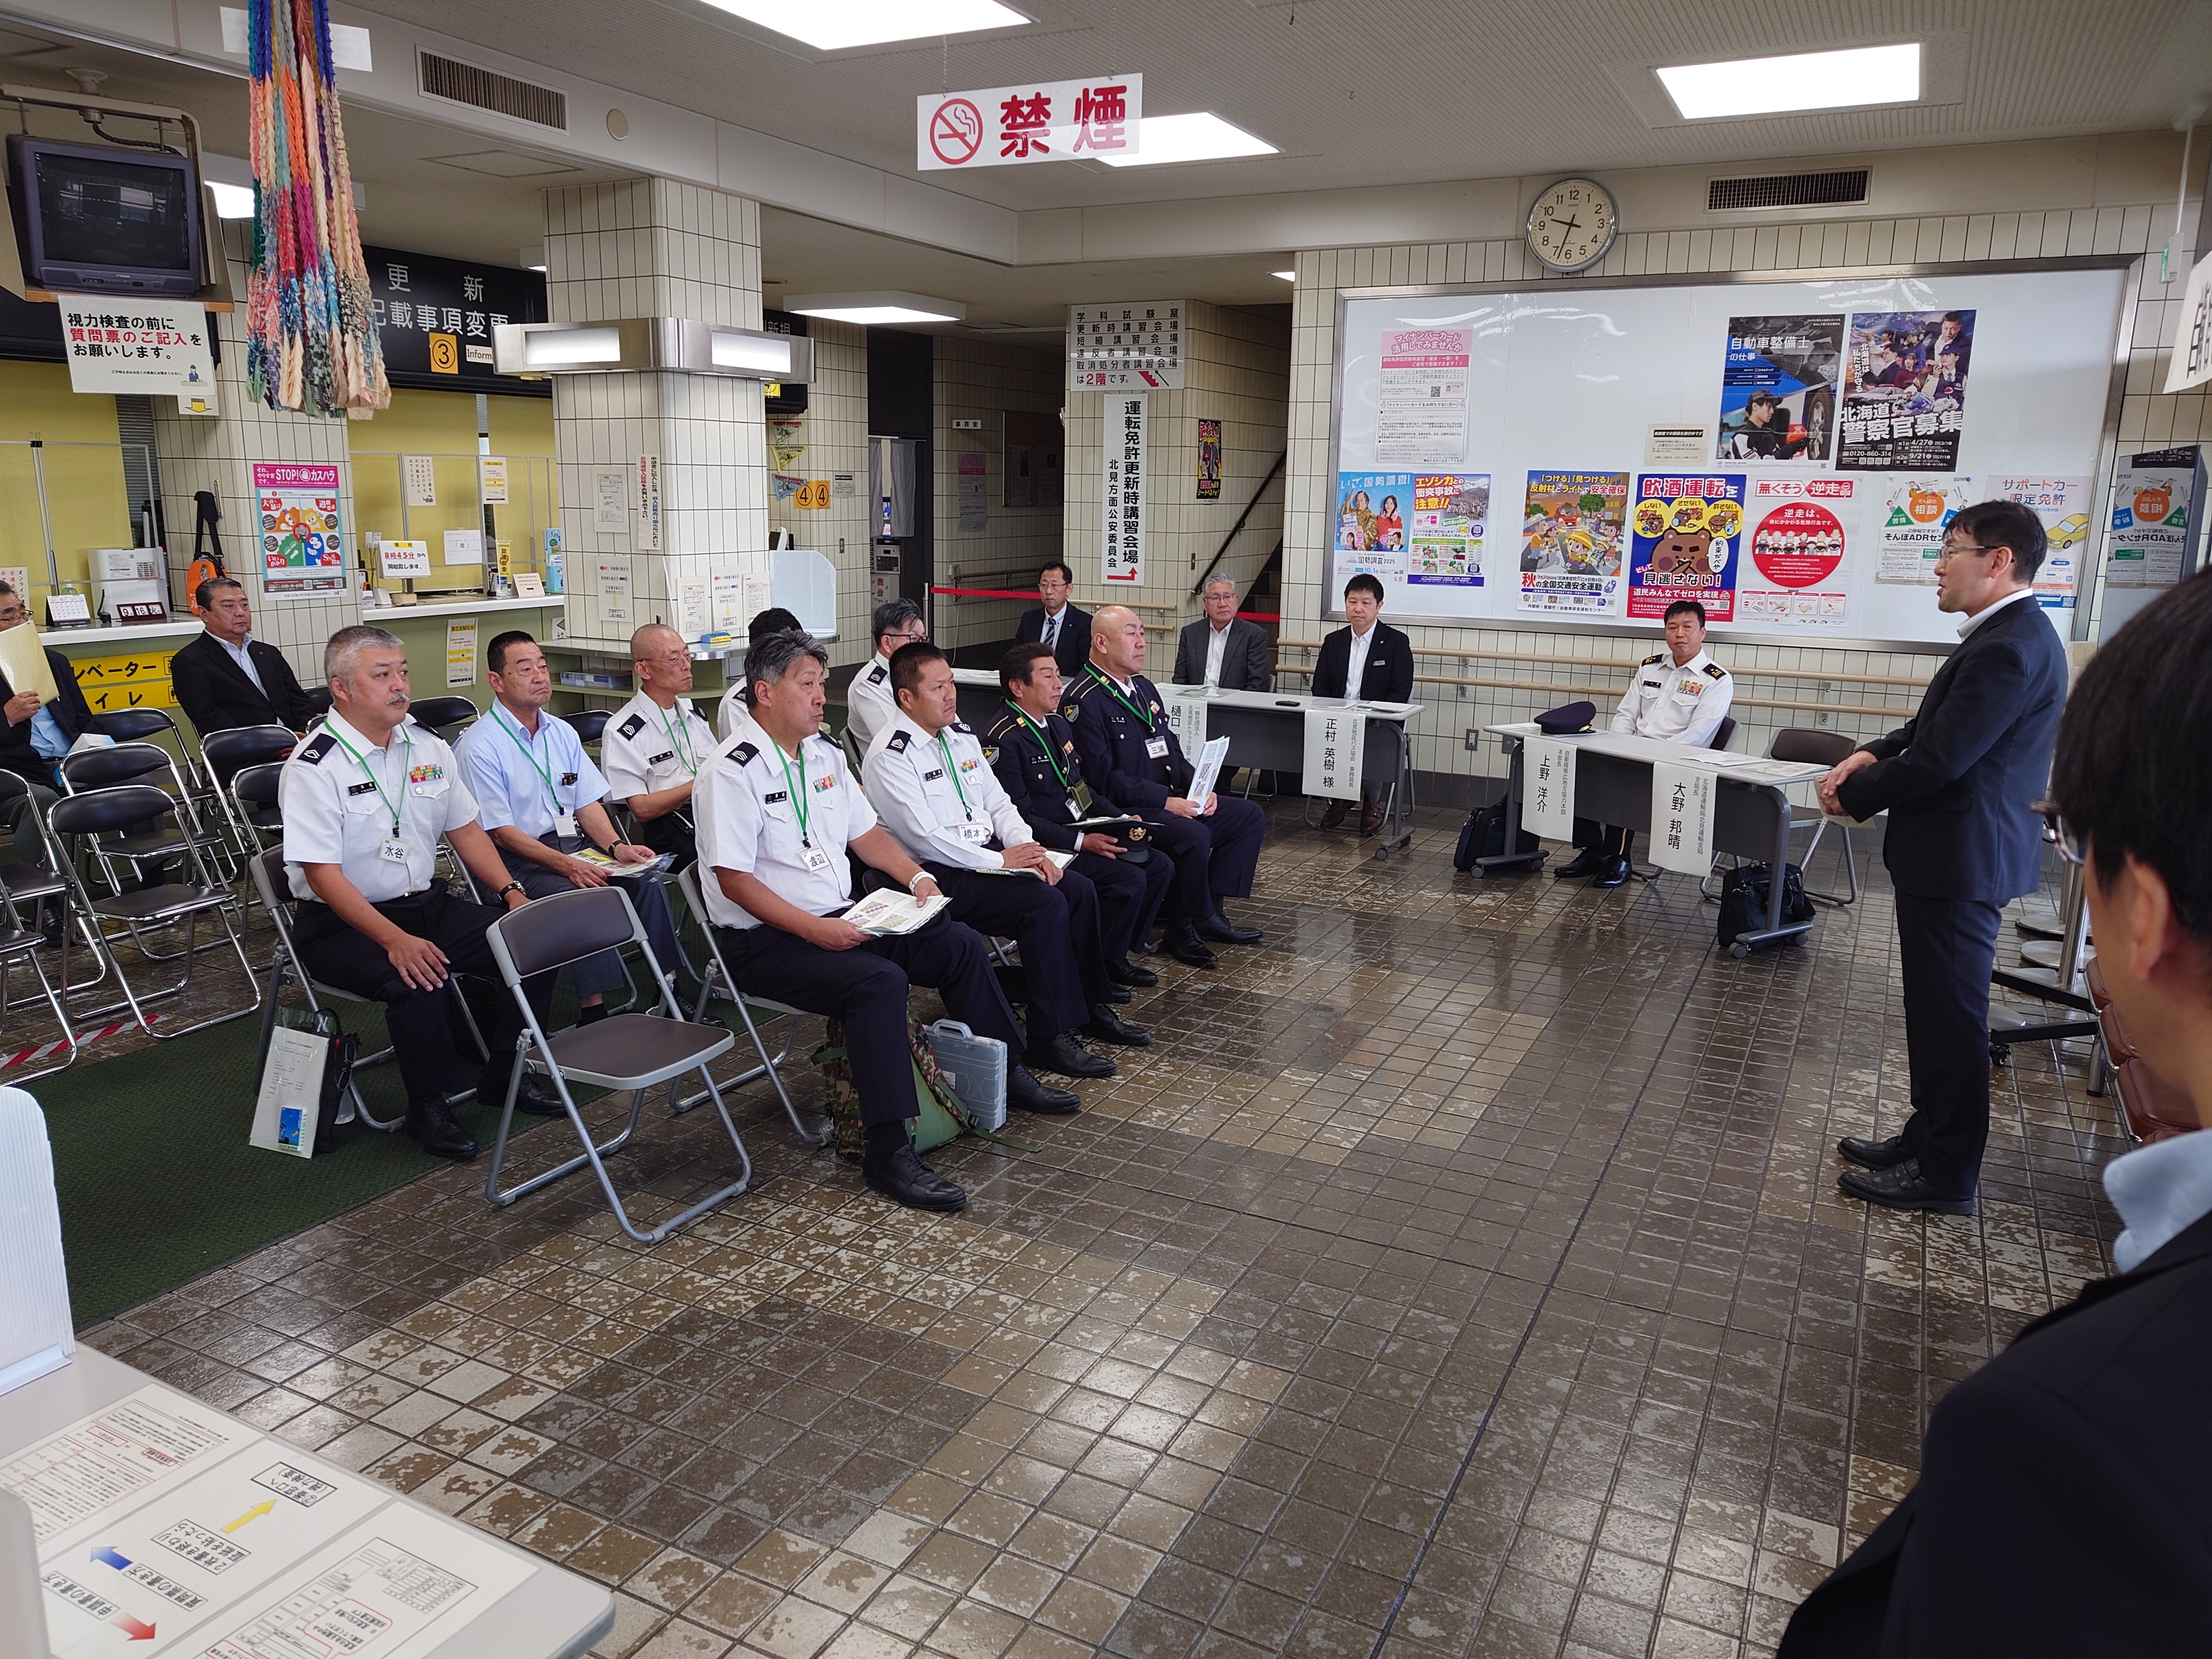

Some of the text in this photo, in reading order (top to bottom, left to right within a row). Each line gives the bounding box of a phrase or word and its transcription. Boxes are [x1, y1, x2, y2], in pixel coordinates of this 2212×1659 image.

[1000, 85, 1127, 158] 禁煙
[1556, 194, 1563, 205] 11
[1569, 190, 1579, 200] 12
[1587, 193, 1590, 203] 1
[1544, 206, 1554, 216] 10
[1594, 204, 1602, 214] 2
[1538, 221, 1545, 230] 9
[1597, 218, 1605, 229] 3
[1542, 236, 1549, 246] 8
[1591, 234, 1598, 244] 4
[1553, 246, 1559, 256] 7
[1565, 250, 1572, 259] 6
[1579, 245, 1587, 255] 5
[1077, 309, 1178, 320] 学科試験室
[67, 313, 175, 330] 視力検査の前に
[1077, 321, 1178, 334] 更新時講習会場
[70, 328, 202, 346] 質問票のご記入を
[1077, 333, 1178, 346] 短縮講習会場
[1395, 330, 1461, 342] マイナンバーカード
[1392, 341, 1463, 354] 活用してみませんか
[1731, 336, 1810, 349] 自動車整備士
[74, 344, 171, 360] お願いします。
[467, 348, 492, 360] Inform
[1077, 346, 1177, 358] 違反者講習会場
[1730, 352, 1756, 361] の仕事
[1860, 343, 1870, 373] 北海道は
[1077, 358, 1177, 370] 取消処分者講習会場
[1852, 349, 1863, 392] 私たちが守る
[1840, 403, 1891, 423] 北海道
[1843, 411, 1962, 444] 警察官募集
[276, 469, 335, 482] STOP! カスハラ
[1541, 475, 1610, 484] 「つける」「見つける」
[1122, 401, 1141, 564] 運転免許更新時講習会場
[1341, 475, 1410, 489] いざ、国勢調査!
[1415, 476, 1464, 488] エゾシカとの
[1642, 478, 1739, 498] 飲酒運転を
[2003, 479, 2078, 490] サポートカー
[1415, 487, 1460, 498] 衝突事故に
[1530, 484, 1627, 494] 反射材とライトで安全確保
[1759, 482, 1839, 495] 無くそう 逆走
[1415, 498, 1450, 510] 注意!!
[2010, 493, 2066, 505] 限定免許
[1108, 459, 1119, 568] 北見方面公安委員会
[1784, 509, 1820, 518] 逆走は、
[1915, 505, 1938, 515] 相談
[1713, 540, 1724, 569] 約束だべや
[1635, 563, 1653, 573] そして
[1644, 573, 1722, 586] 見逃さない!
[1633, 588, 1719, 599] 道民みんなでゼロを実現
[1171, 705, 1181, 727] 樋口
[1350, 719, 1358, 761] 北見地区バス協会
[1150, 744, 1165, 756] 三浦
[1323, 718, 1338, 788] 正村 英樹 様
[1537, 754, 1550, 813] 上野 洋介
[1560, 750, 1570, 815] 自衛隊帯広地方協力本部
[1668, 782, 1686, 850] 大野 邦晴
[1697, 778, 1708, 855] 北海道運輸局北見運輸支局
[963, 828, 981, 839] 橋本
[385, 845, 404, 860] 水谷
[128, 1564, 205, 1609] 質問票の書き方
[42, 1571, 112, 1617] 申請書の書き方
